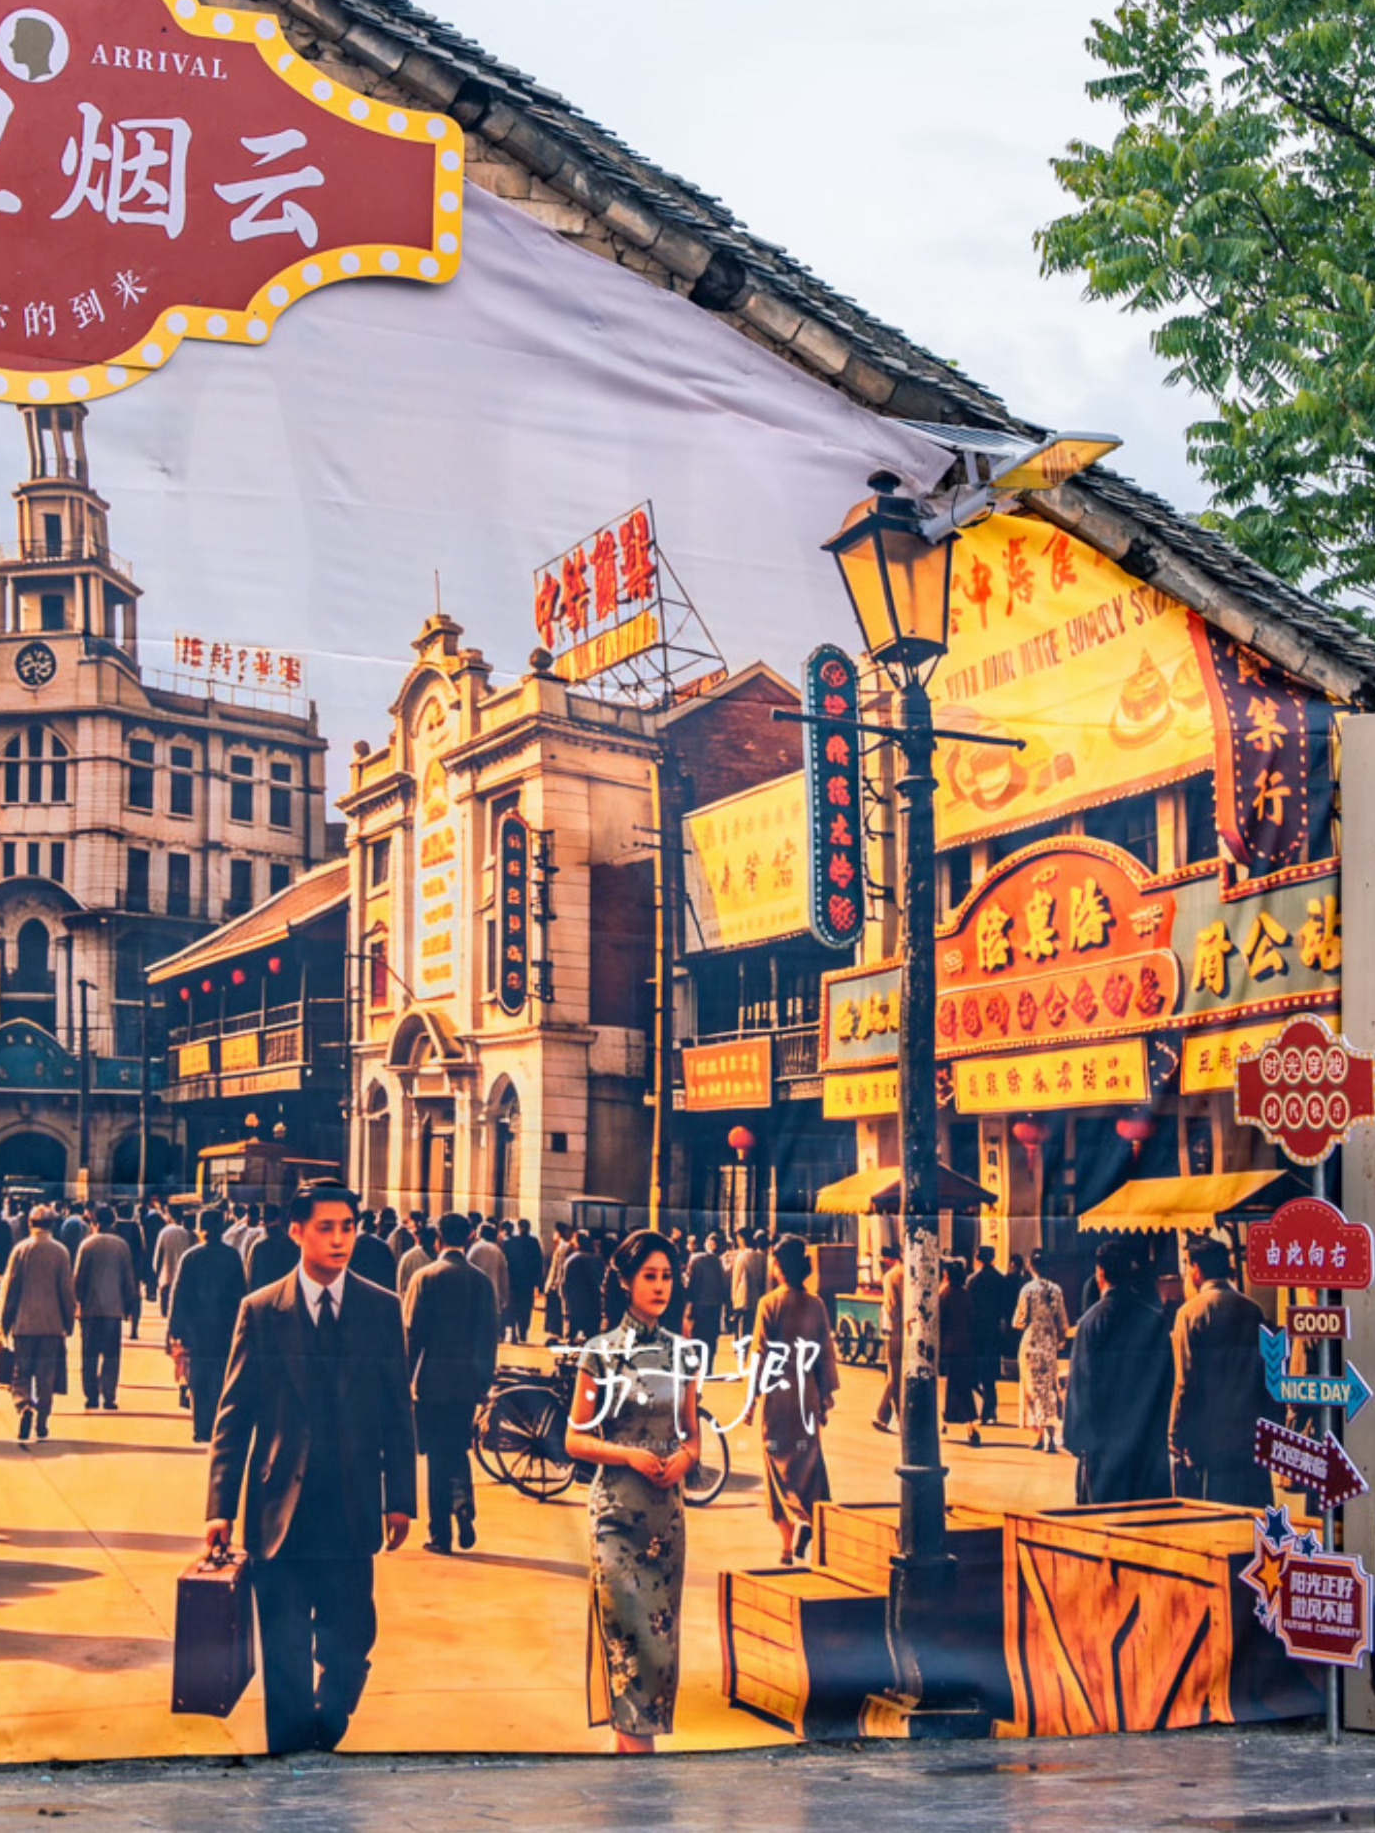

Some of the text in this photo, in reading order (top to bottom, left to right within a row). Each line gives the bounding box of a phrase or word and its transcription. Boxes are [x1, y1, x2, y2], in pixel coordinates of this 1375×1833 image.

[90, 44, 229, 81] ARRIVAL
[1263, 1055, 1346, 1078] 时光穿梭
[1265, 1101, 1343, 1119] 时代歌厅
[1265, 1238, 1347, 1268] 由此向右
[1293, 1312, 1340, 1332] GOOD
[1281, 1380, 1351, 1402] NICE DAY
[1290, 1571, 1354, 1600] 阳光正好
[1291, 1597, 1354, 1626] 微风不燥
[1283, 1619, 1361, 1637] FUTURE COMMUNITY
